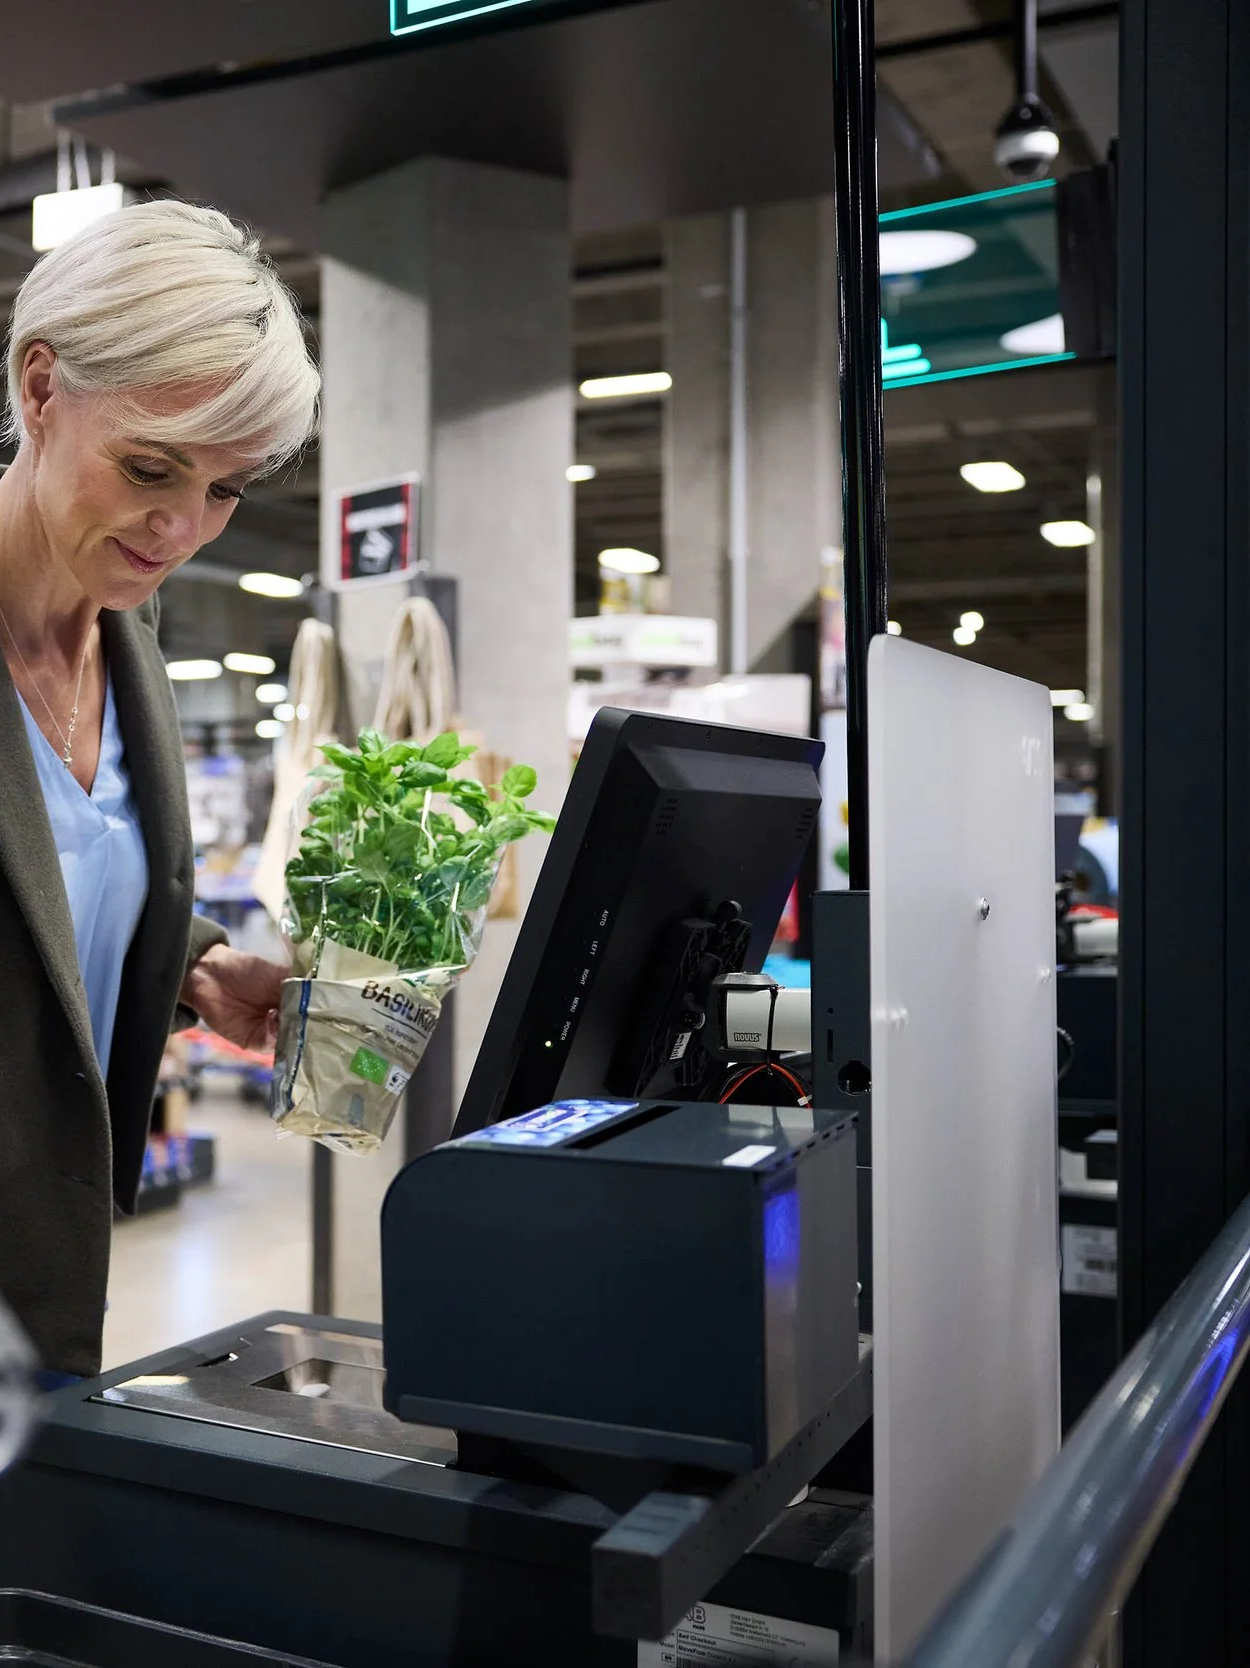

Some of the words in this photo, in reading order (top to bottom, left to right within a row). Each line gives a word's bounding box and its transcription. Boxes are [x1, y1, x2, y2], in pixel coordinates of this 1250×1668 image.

[599, 909, 609, 926] AUTO
[589, 940, 598, 956] LEFT
[579, 968, 589, 985] RIGHT
[570, 996, 579, 1013] MENU
[560, 1021, 571, 1041] POWER
[690, 1635, 716, 1646] Checkout
